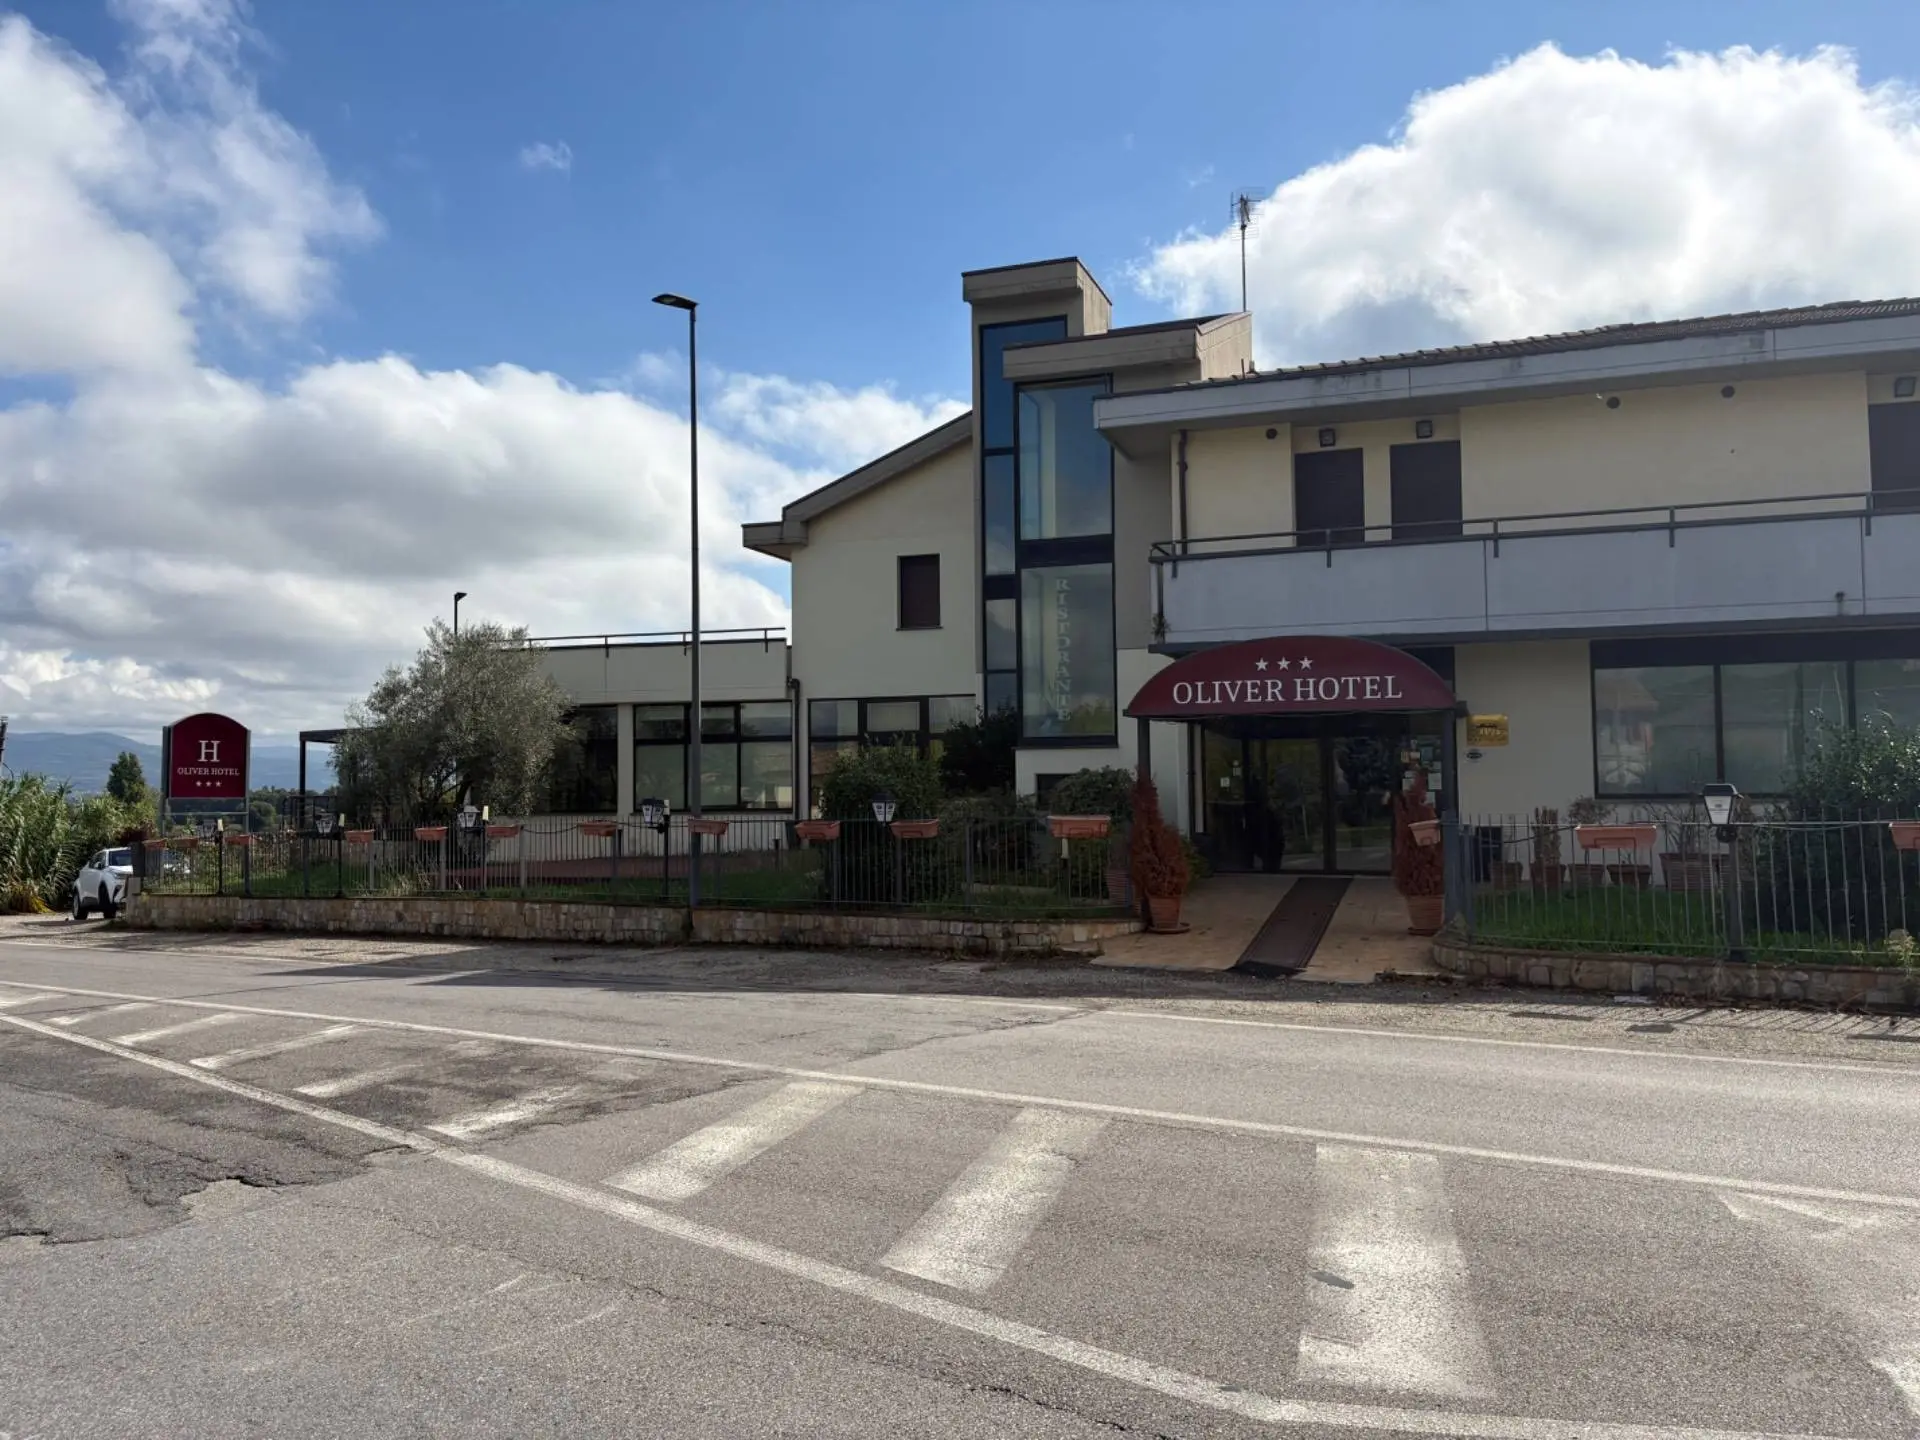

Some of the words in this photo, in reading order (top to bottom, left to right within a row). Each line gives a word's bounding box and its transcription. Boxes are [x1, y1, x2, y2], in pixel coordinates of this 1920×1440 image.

[1056, 578, 1071, 721] RISTORANTE
[1172, 679, 1285, 704] OLIVER
[1294, 675, 1402, 701] HOTEL
[198, 740, 220, 762] H
[177, 767, 209, 776] OLIVER
[211, 768, 240, 776] HOTEL
